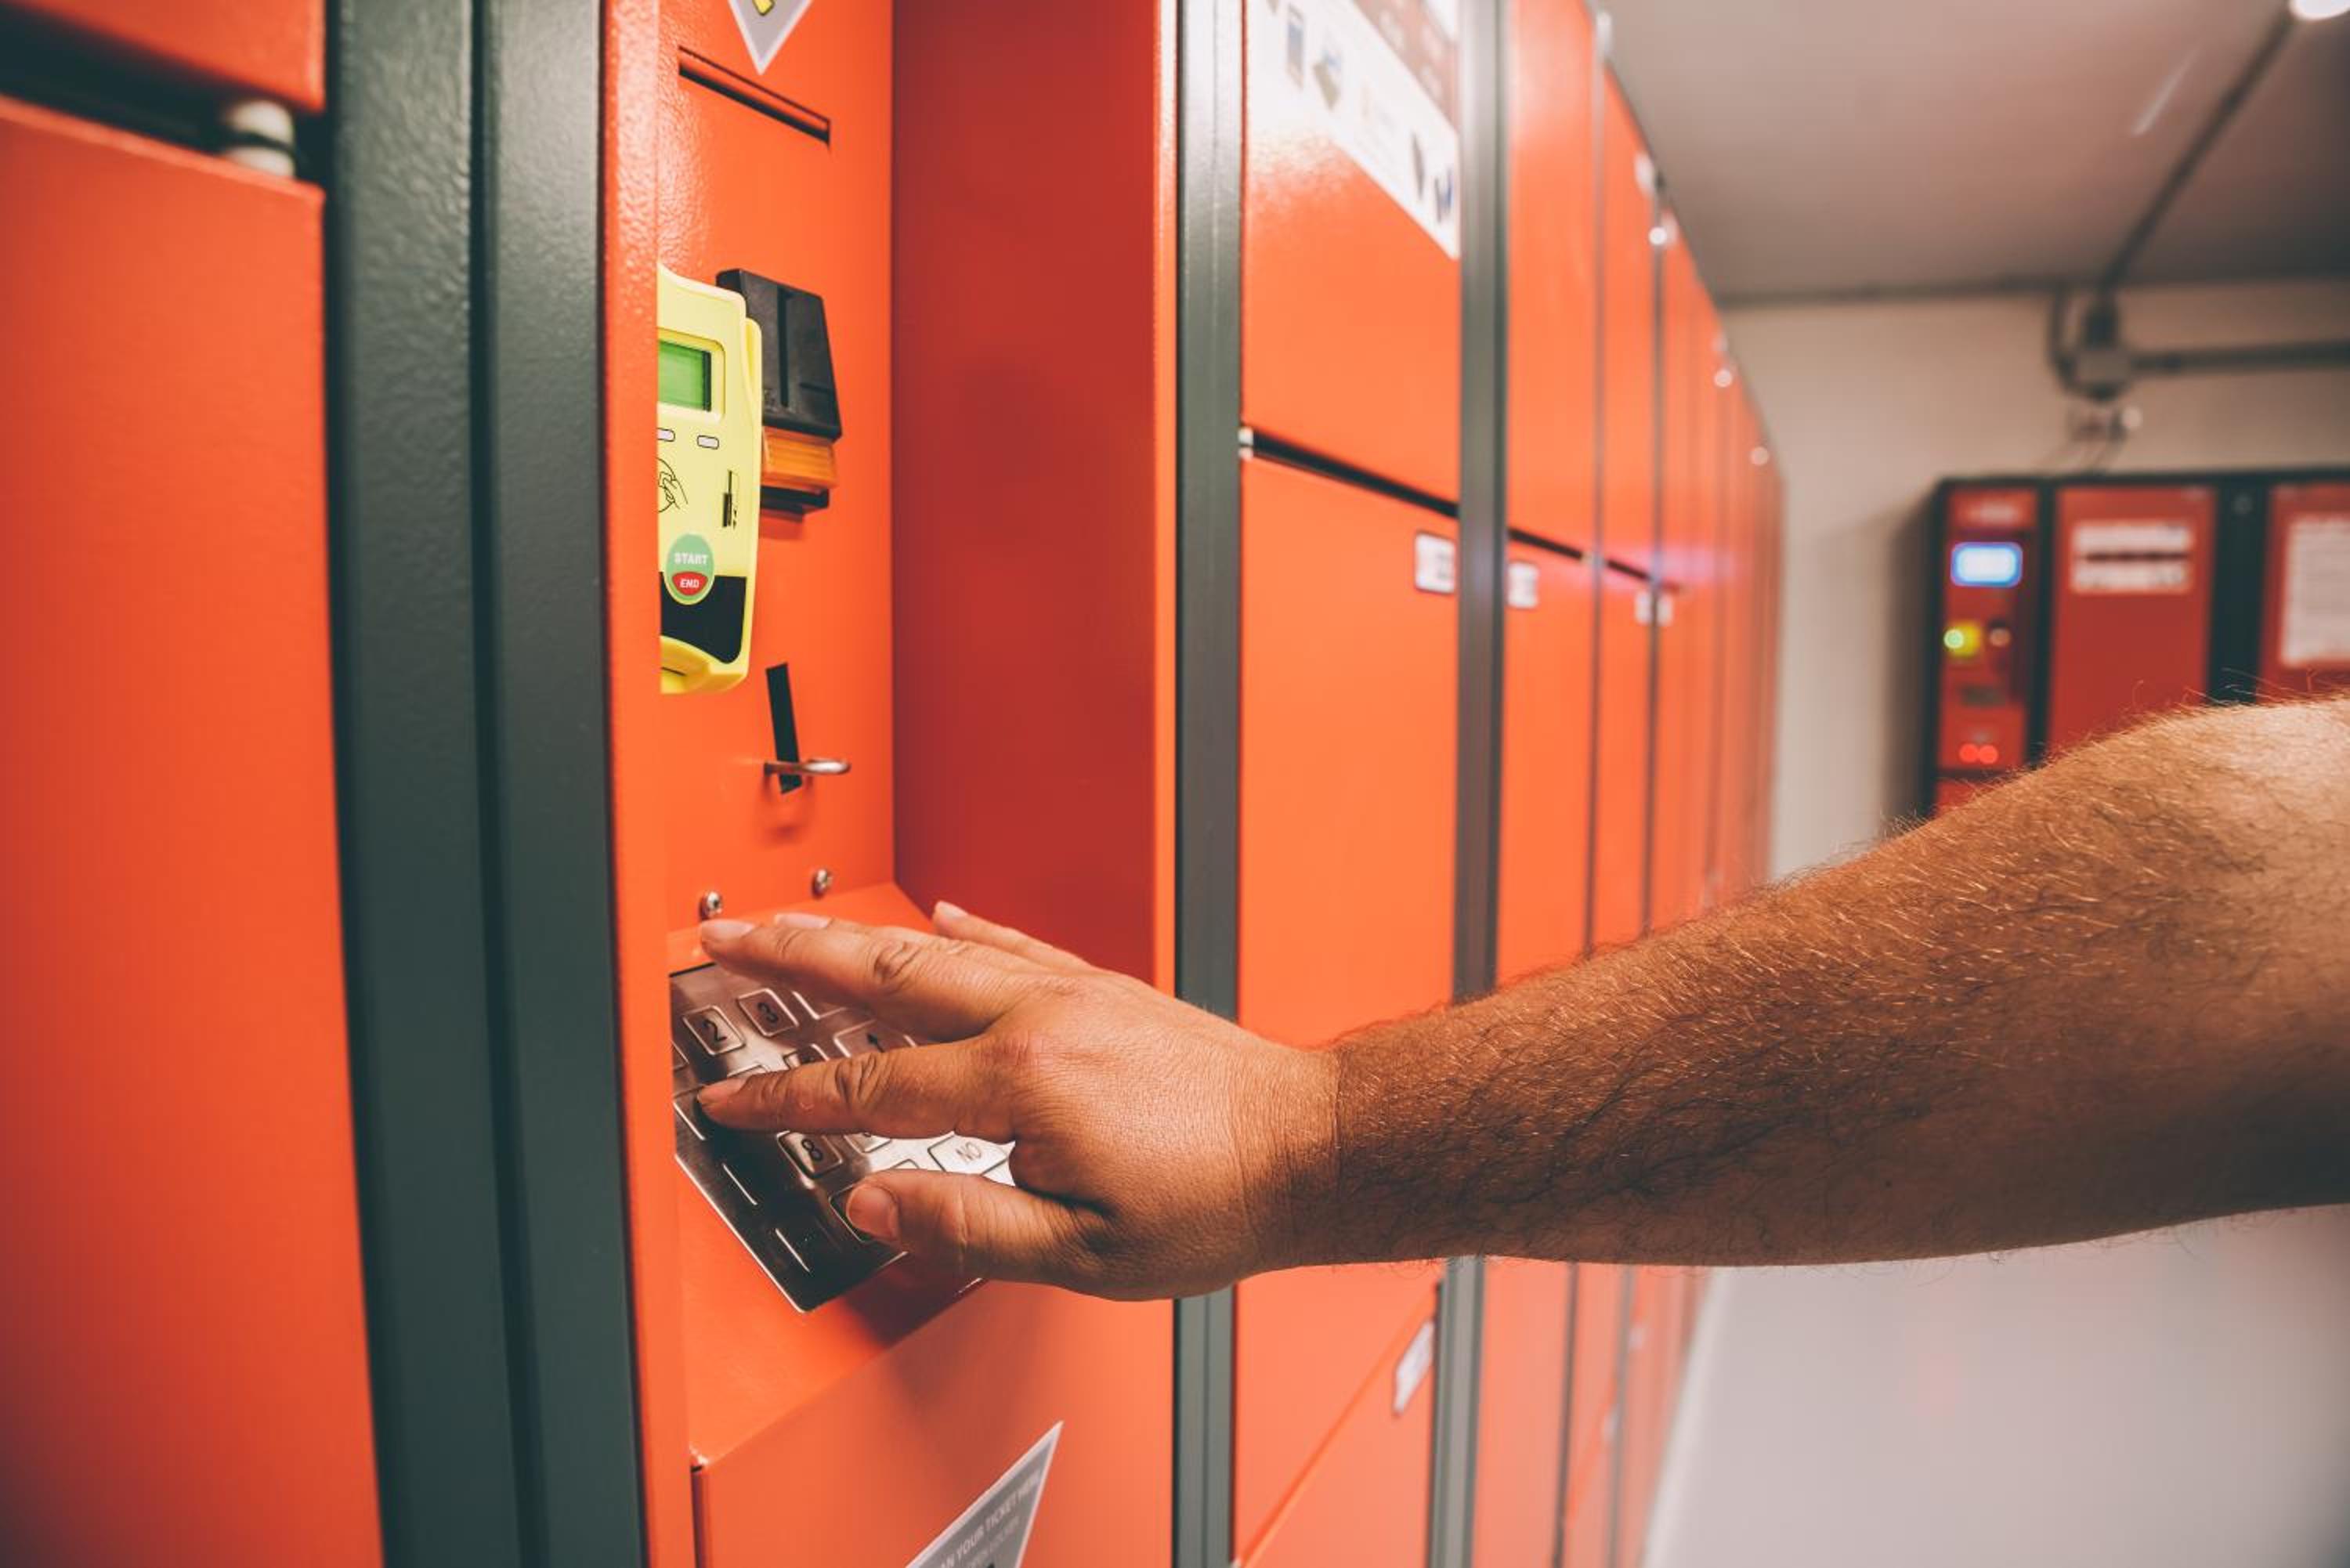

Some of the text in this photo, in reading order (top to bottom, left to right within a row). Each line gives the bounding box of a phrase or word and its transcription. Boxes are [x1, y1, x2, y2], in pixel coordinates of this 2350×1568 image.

[674, 552, 708, 565] START
[680, 578, 700, 589] END
[703, 1019, 727, 1042] 2
[801, 1138, 822, 1162] 8
